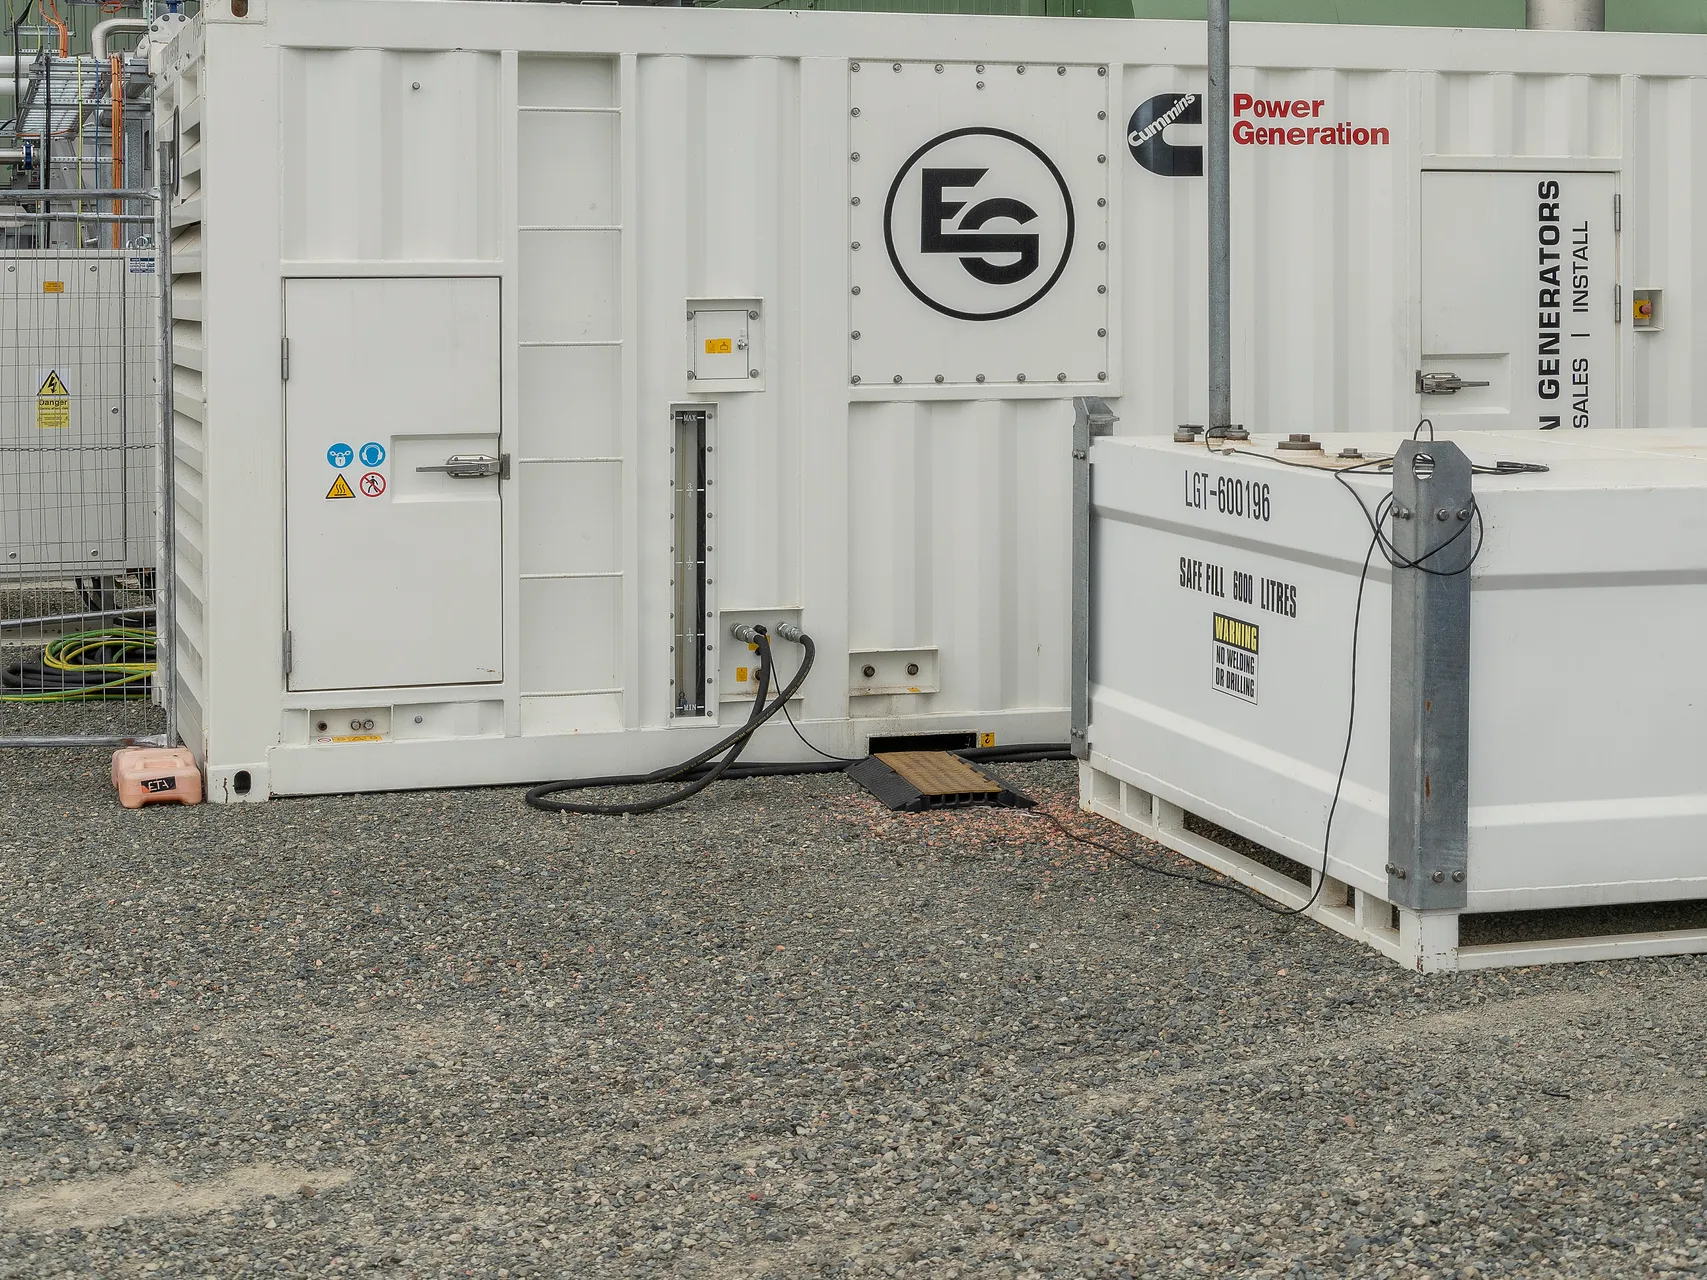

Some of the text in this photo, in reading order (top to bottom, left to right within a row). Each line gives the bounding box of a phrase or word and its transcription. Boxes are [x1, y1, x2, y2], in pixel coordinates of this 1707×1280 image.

[1127, 92, 1196, 148] Cummins
[1233, 93, 1325, 118] Power
[1232, 121, 1390, 145] Generation
[1572, 221, 1589, 312] INSTALL
[1538, 180, 1560, 400] GENERATORS
[1572, 358, 1589, 429] SALES
[683, 414, 697, 422] MAX
[1185, 470, 1270, 522] LGT-600196
[1180, 556, 1297, 618] SAFE FILL 6000 LITRES
[1215, 615, 1257, 651] WARNING
[1216, 645, 1255, 675] NO WELDING
[1216, 667, 1255, 698] OR DRILLING
